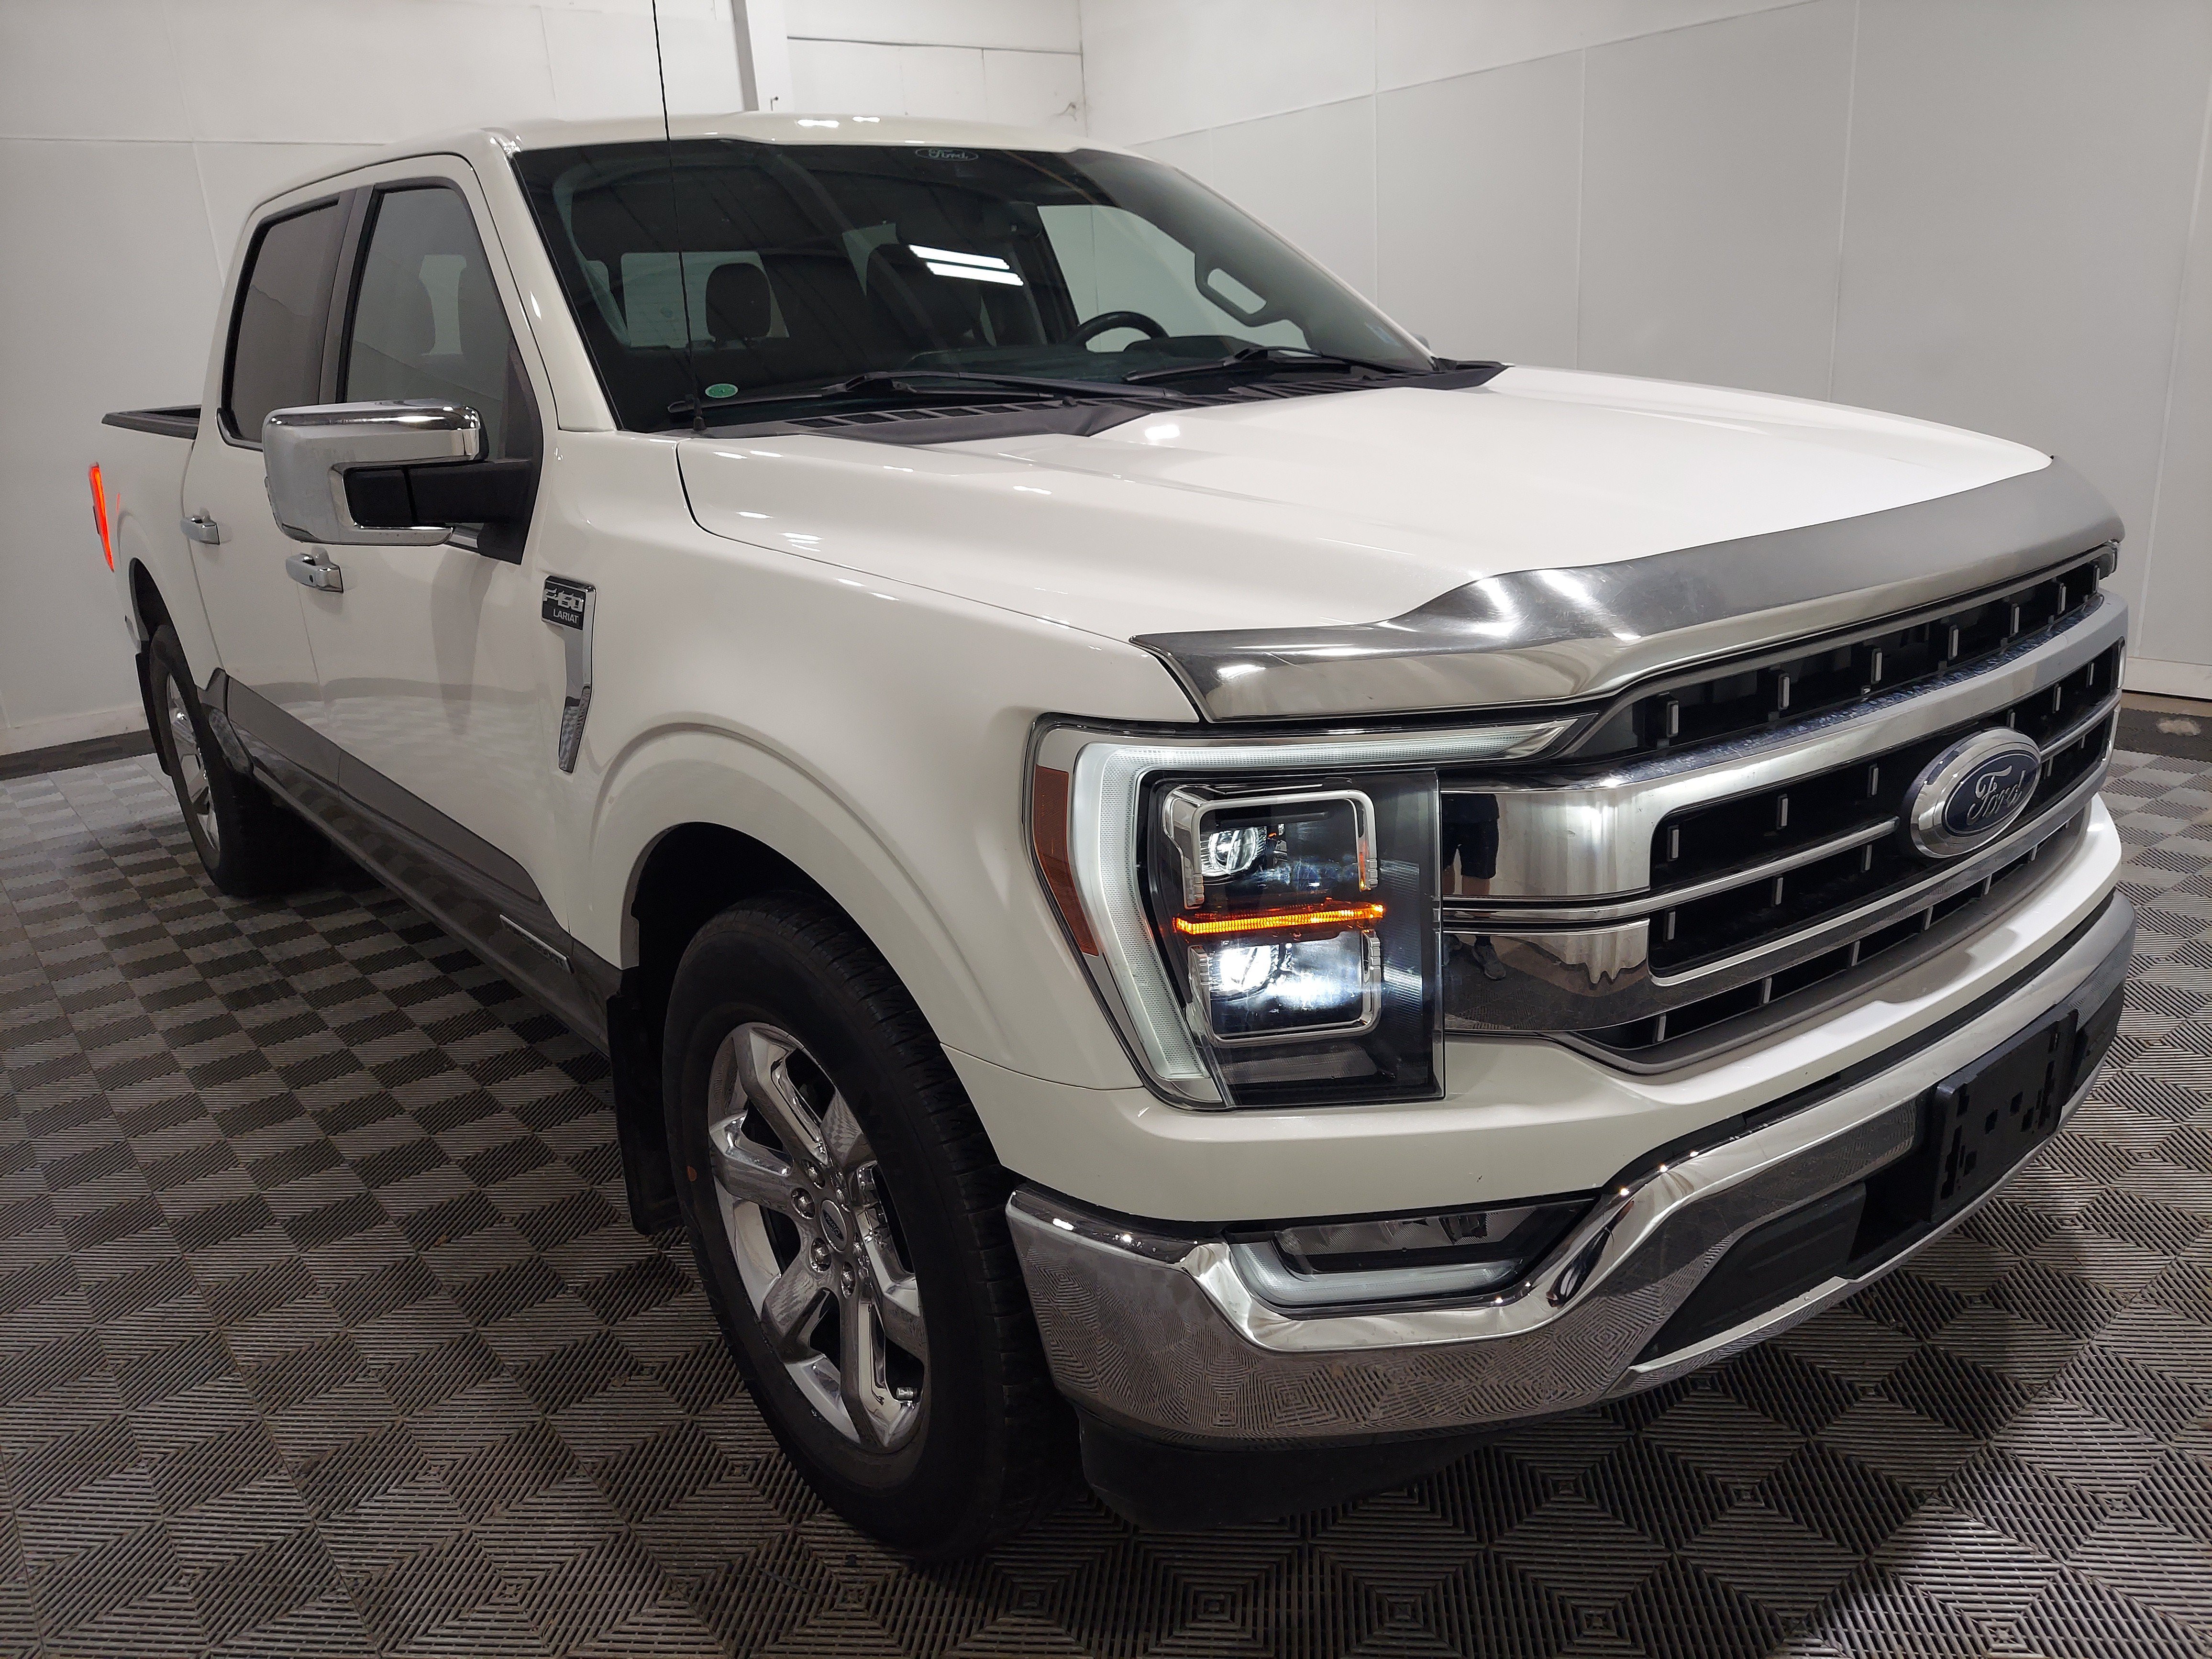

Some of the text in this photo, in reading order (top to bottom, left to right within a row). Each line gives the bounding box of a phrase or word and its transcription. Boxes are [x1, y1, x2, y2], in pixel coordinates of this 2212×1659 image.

[929, 148, 968, 159] Ford
[553, 608, 579, 624] LARIAT
[1967, 765, 2026, 826] Ford
